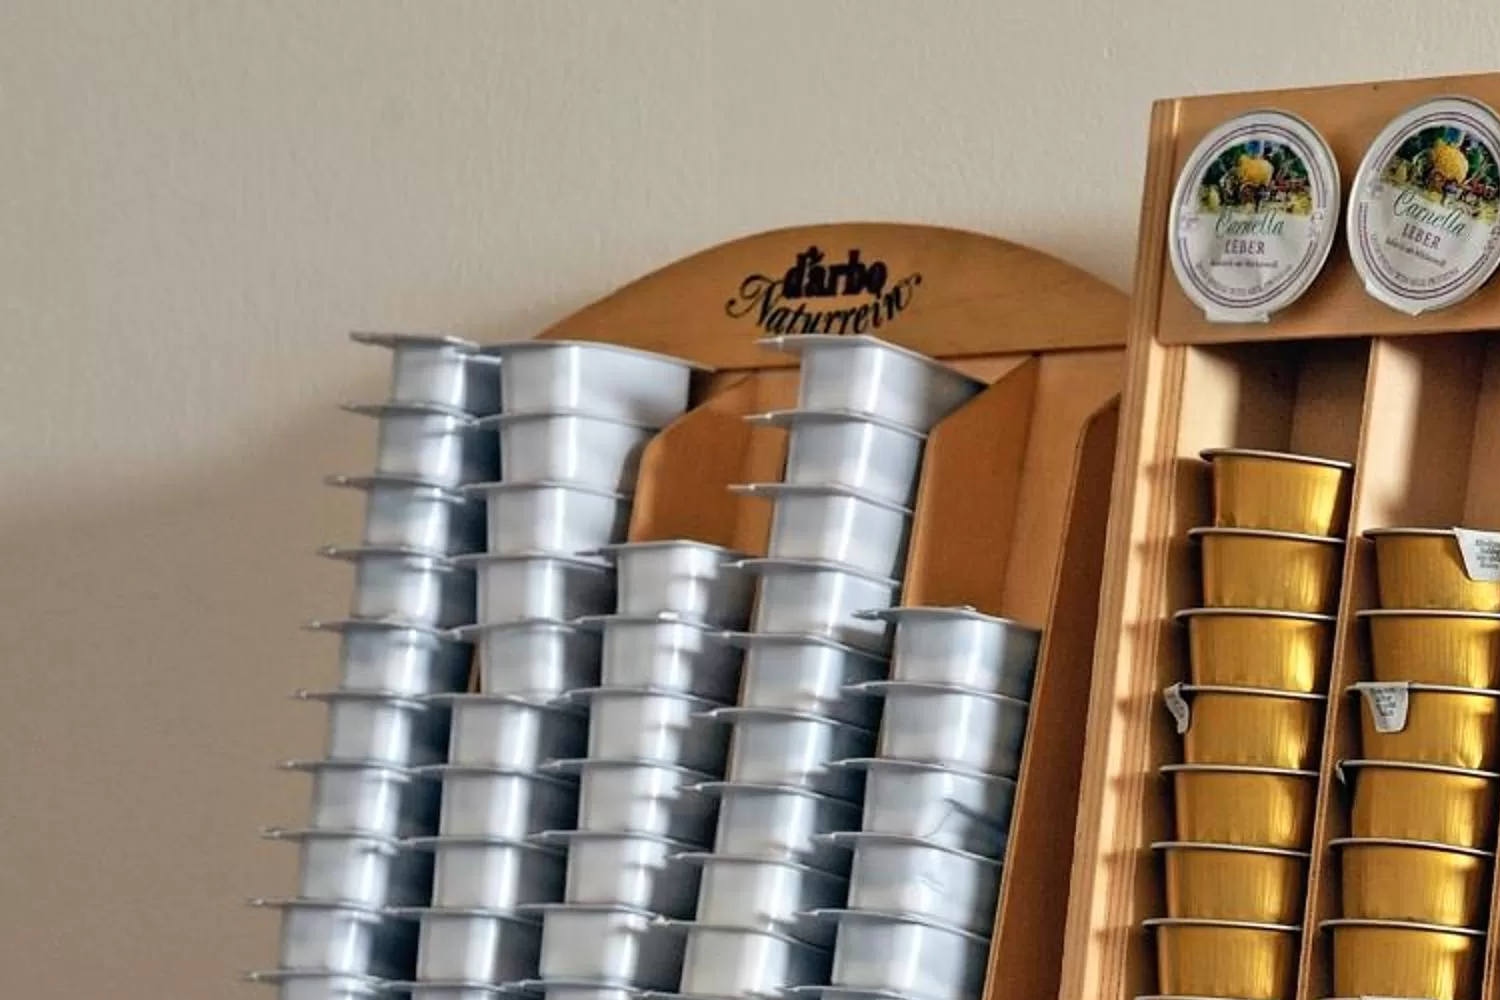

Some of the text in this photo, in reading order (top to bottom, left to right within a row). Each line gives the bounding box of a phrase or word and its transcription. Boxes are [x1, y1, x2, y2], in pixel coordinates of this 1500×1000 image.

[1215, 204, 1284, 239] Carnella
[1393, 189, 1467, 238] Carnella
[1225, 239, 1265, 255] LEBER
[1402, 223, 1441, 250] LEBER
[725, 272, 922, 335] Naturrein
